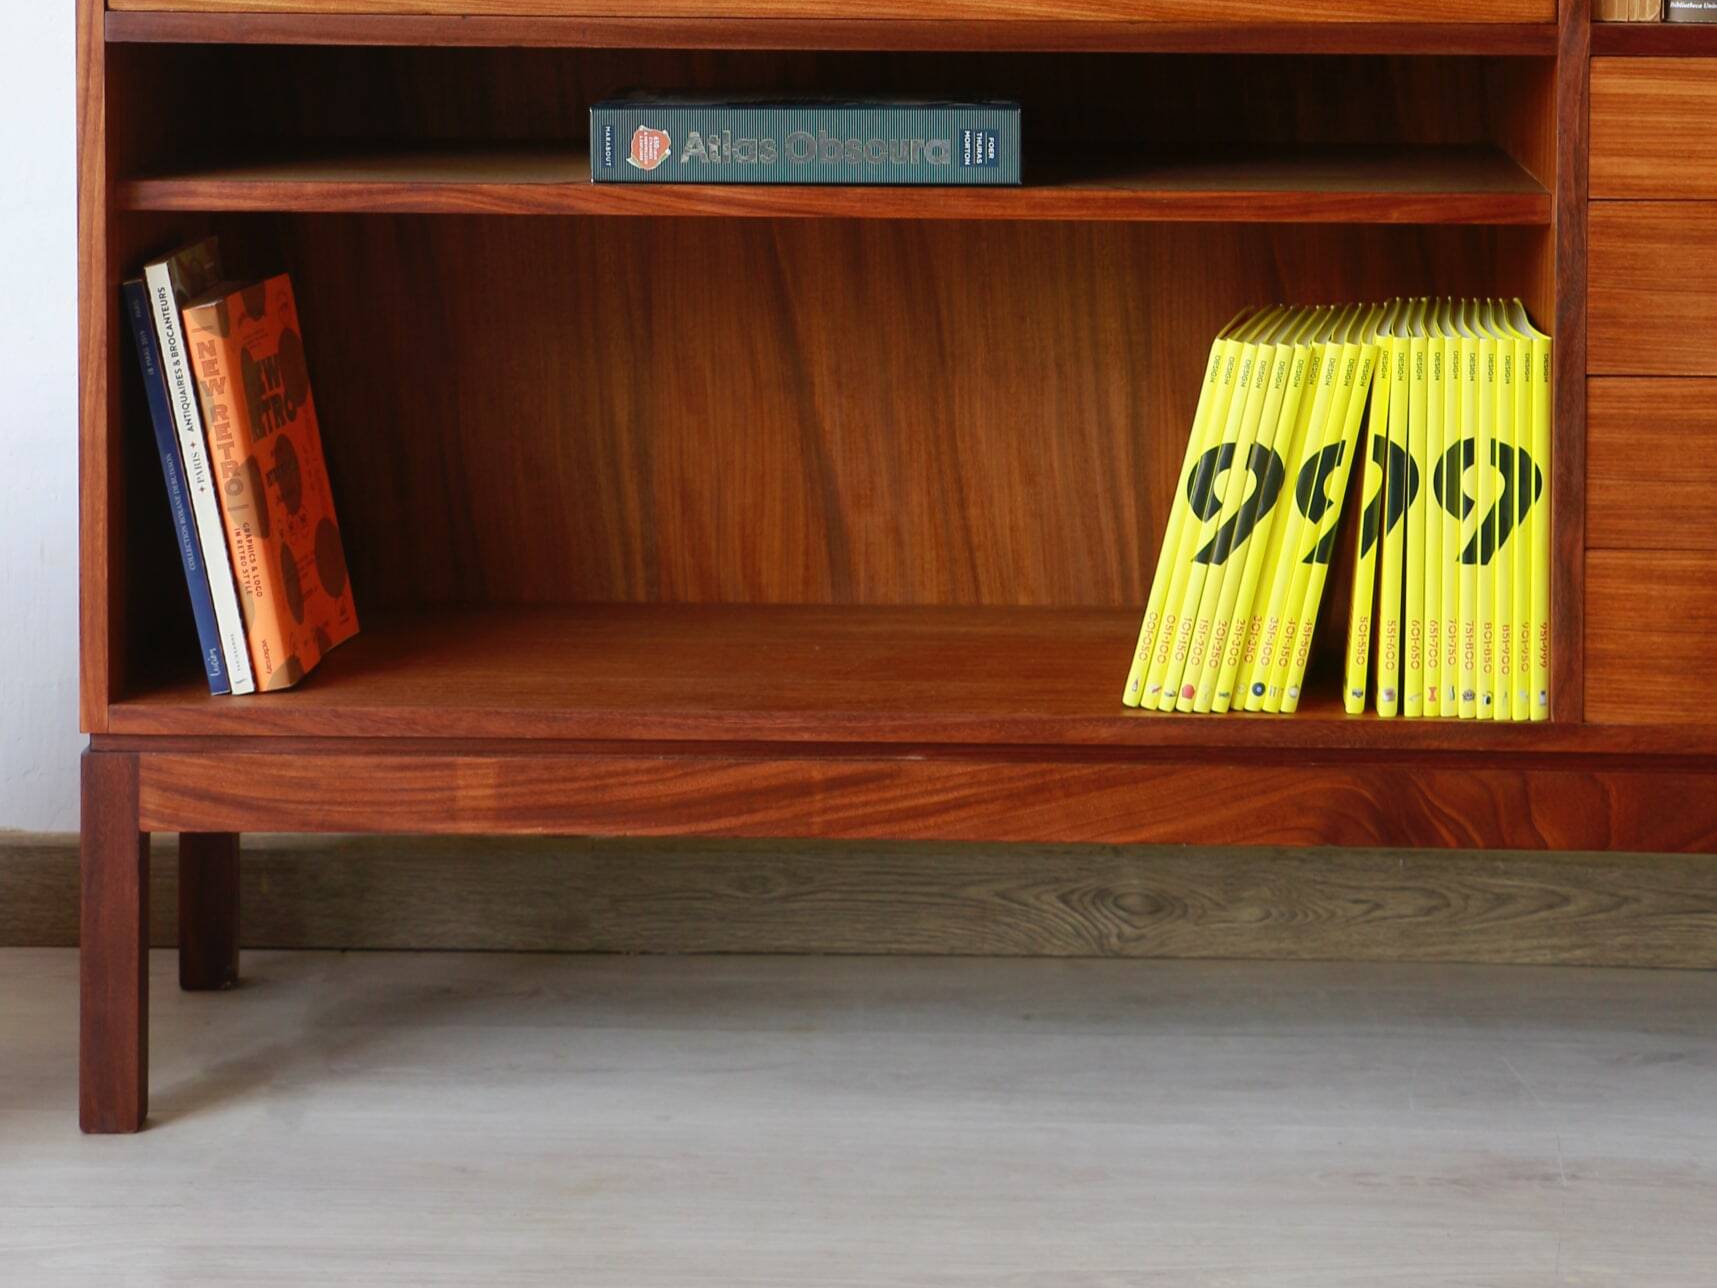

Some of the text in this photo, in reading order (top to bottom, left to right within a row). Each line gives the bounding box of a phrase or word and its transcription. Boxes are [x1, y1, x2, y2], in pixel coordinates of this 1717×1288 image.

[680, 130, 778, 164] Atlas
[785, 130, 951, 164] Obscura
[157, 286, 194, 432] ANTIQUAIRES & BROCANTEURS
[196, 339, 226, 397] NEW
[1210, 355, 1221, 383] DESIGN
[1224, 356, 1235, 385] DESIGN
[1241, 359, 1251, 387] DESIGN
[1256, 360, 1267, 389] DESIGN
[1275, 361, 1285, 389] DESIGN
[1293, 359, 1304, 388] DESIGN
[1309, 356, 1320, 385] DESIGN
[1325, 357, 1336, 386] DESIGN
[1343, 358, 1354, 386] DESIGN
[1360, 358, 1371, 387] DESIGN
[1381, 351, 1389, 379] DESIGN
[192, 451, 205, 484] PARIS
[210, 404, 244, 496] RETRO
[182, 525, 196, 571] COLLECTION
[234, 528, 253, 594] IN RETRO STYLE
[243, 522, 257, 564] GRAPHICS
[1139, 612, 1158, 661] 001-050
[1157, 615, 1176, 664] 051-100
[1175, 617, 1192, 661] 101-150
[1191, 618, 1209, 666] 151-200
[1209, 620, 1228, 669] 201-250
[1227, 619, 1246, 666] 251-300
[1244, 616, 1262, 663] 301-350
[1356, 616, 1368, 666] 501-550
[1385, 620, 1397, 671] 551-600
[1410, 619, 1421, 670] 601-650
[1428, 620, 1438, 669] 651-700
[1448, 618, 1457, 666] 701-750
[1465, 620, 1474, 671] 751-800
[1483, 622, 1493, 674] 801-850
[1501, 624, 1510, 675] 851-900
[1521, 622, 1529, 673] 901-950
[1539, 622, 1548, 669] 951-999
